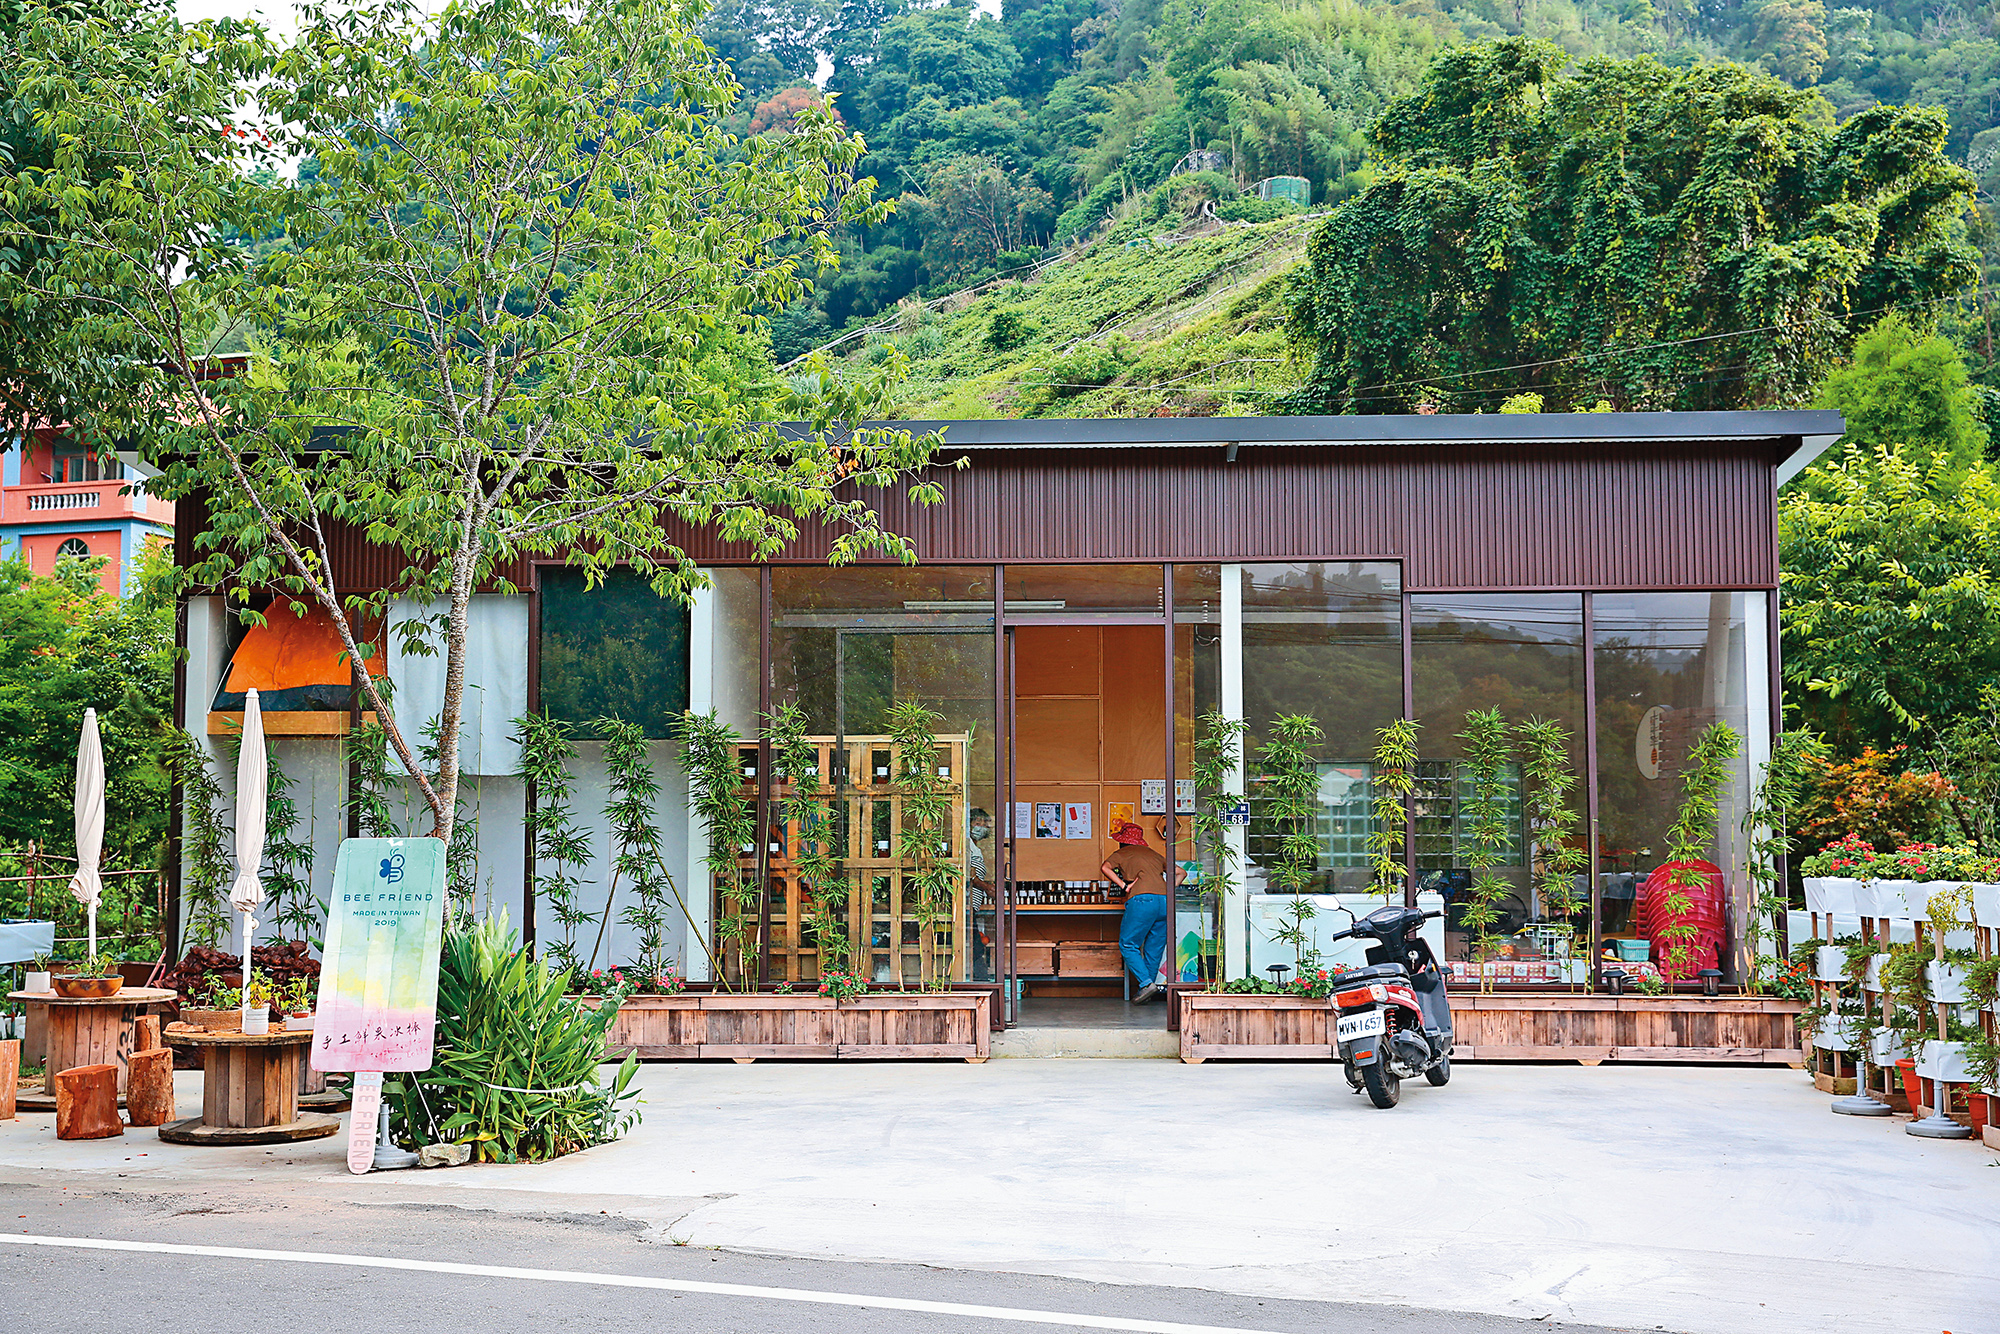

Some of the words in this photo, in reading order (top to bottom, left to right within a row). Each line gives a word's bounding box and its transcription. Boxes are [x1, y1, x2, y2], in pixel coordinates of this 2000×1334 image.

[1231, 814, 1244, 825] 68
[343, 893, 371, 902] BEE
[378, 893, 434, 902] FRIEND
[374, 919, 397, 927] 2019
[358, 1073, 377, 1103] BEE
[351, 1111, 374, 1171] FRIEND
